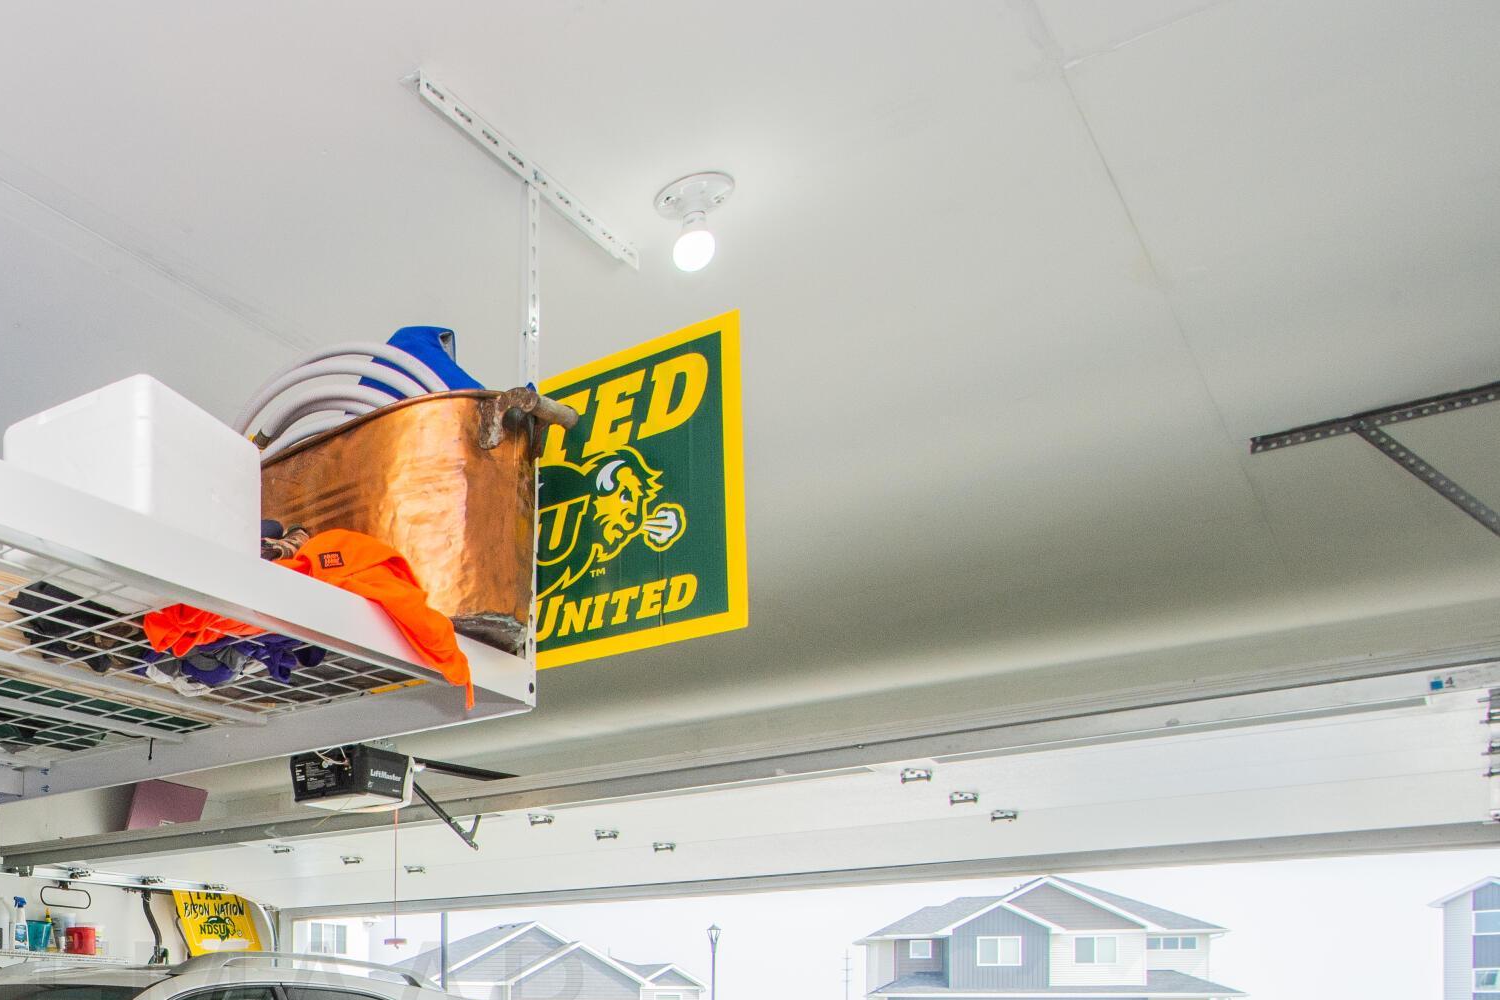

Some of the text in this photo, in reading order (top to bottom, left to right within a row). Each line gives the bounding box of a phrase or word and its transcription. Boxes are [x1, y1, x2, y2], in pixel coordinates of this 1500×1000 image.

[537, 573, 698, 642] UNITED
[370, 768, 402, 782] LiftMaster
[205, 892, 222, 900] AM
[183, 902, 245, 918] BISON NATION
[199, 924, 227, 935] NDSU
